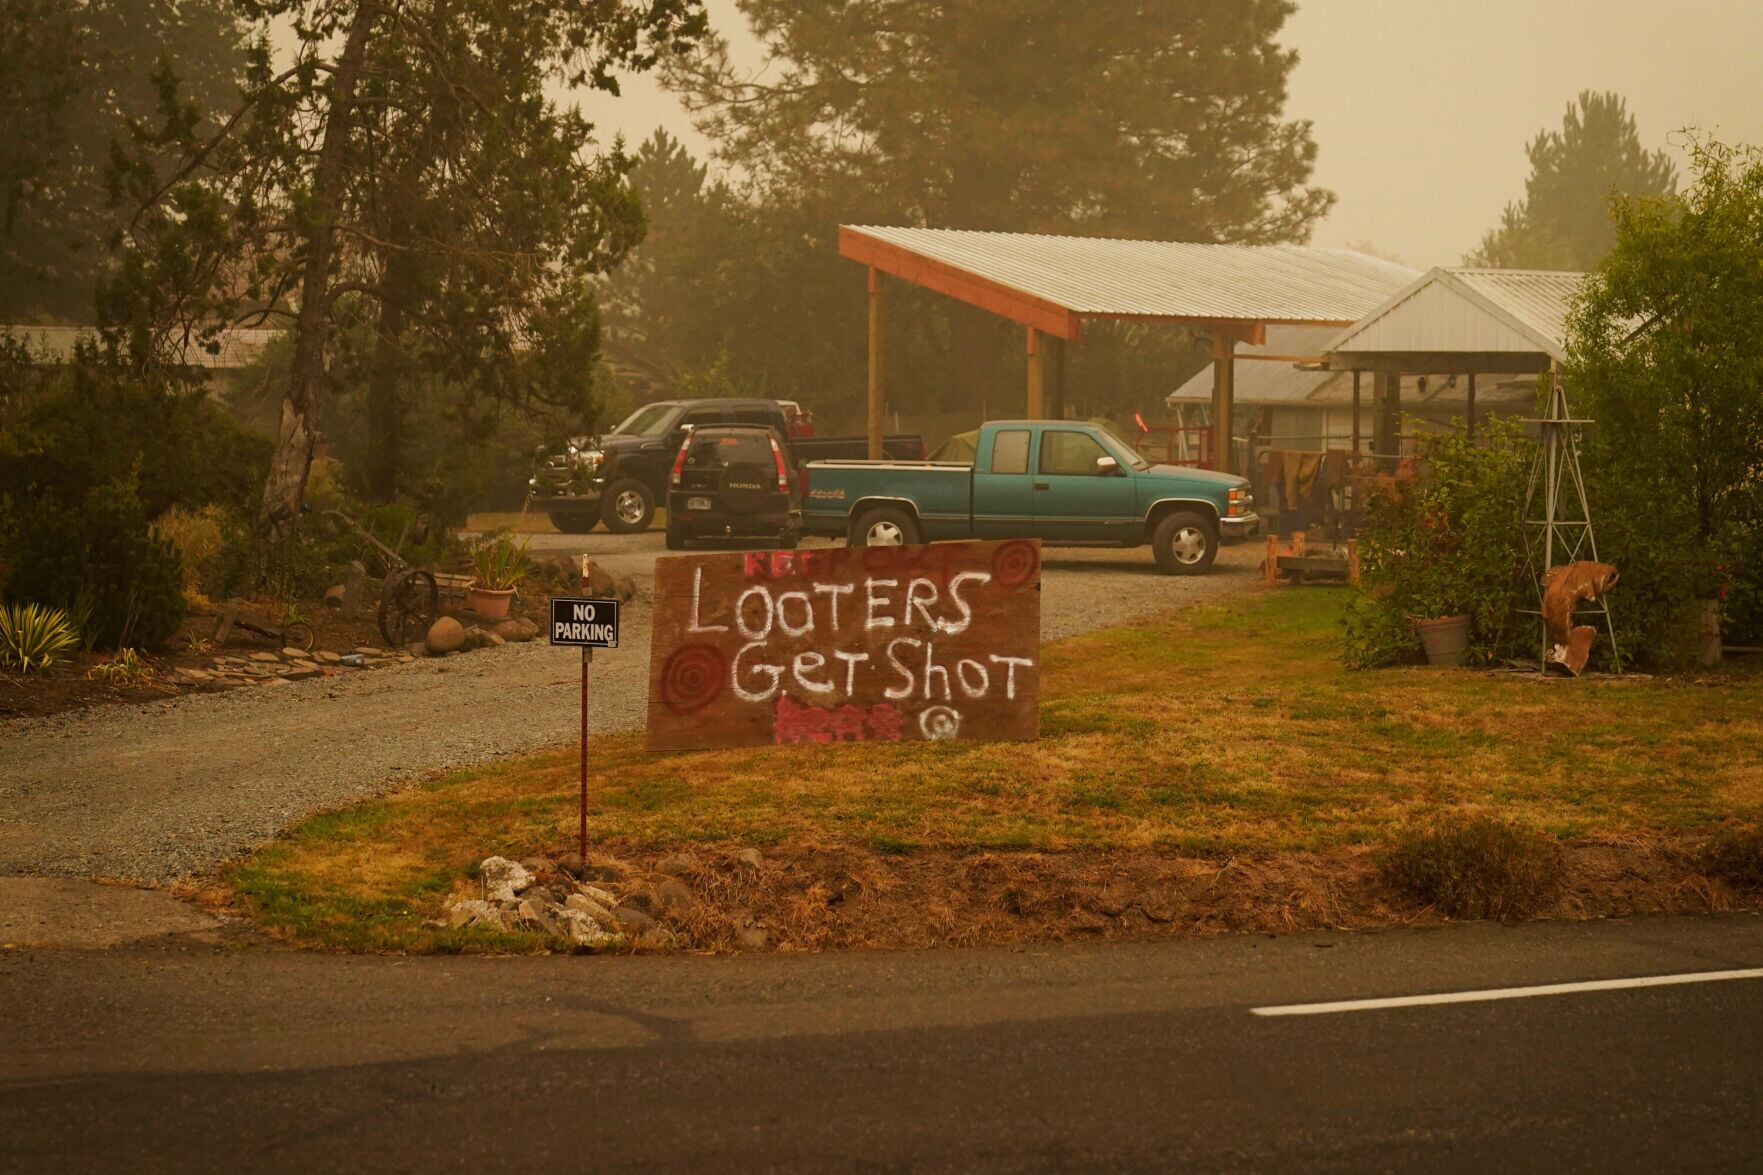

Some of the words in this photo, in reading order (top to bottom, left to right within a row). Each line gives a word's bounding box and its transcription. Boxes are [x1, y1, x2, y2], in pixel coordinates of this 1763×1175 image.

[573, 604, 596, 621] NO
[687, 566, 992, 641] LOOTERS
[555, 621, 614, 641] PARKING
